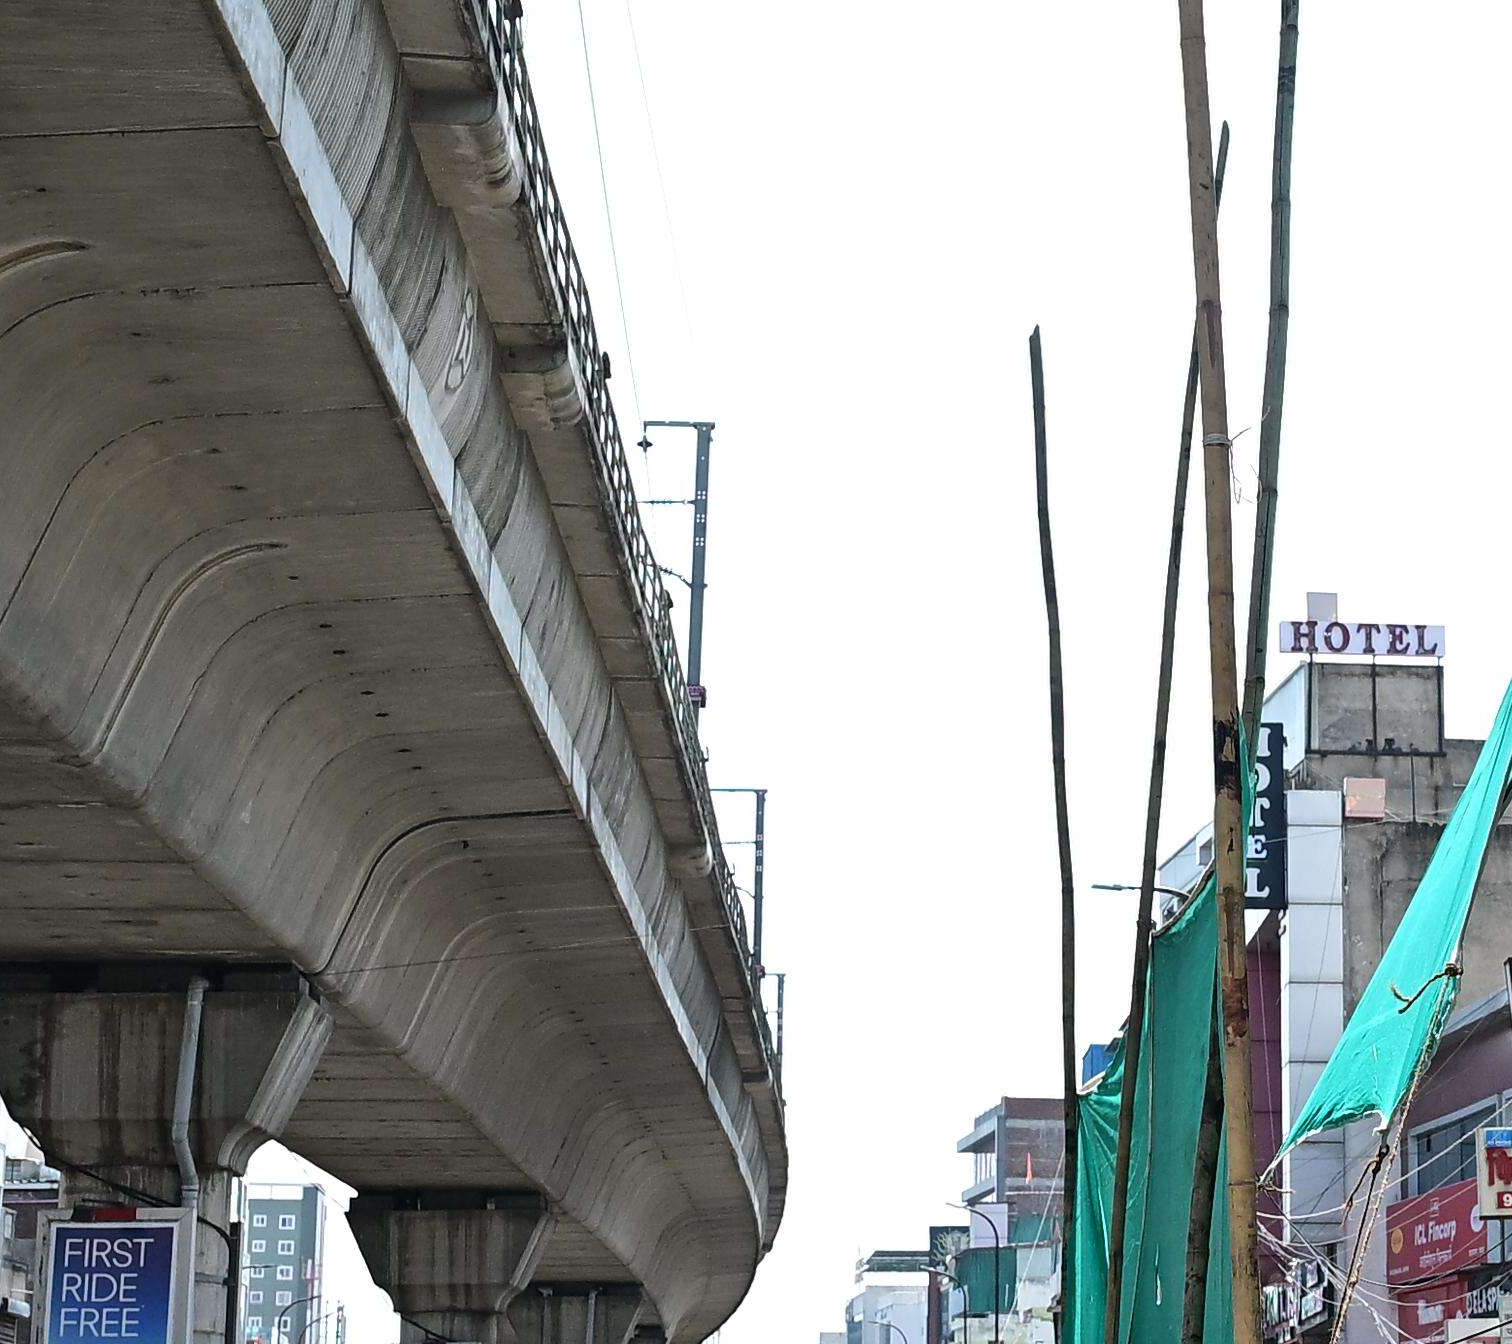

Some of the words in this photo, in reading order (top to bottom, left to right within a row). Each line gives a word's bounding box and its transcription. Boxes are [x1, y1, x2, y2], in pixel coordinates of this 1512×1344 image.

[1290, 621, 1438, 656] HOTEL
[1414, 1224, 1426, 1247] ICL
[1428, 1219, 1456, 1244] Fincorp
[63, 1238, 155, 1269] FIRST
[61, 1273, 138, 1303] RIDE
